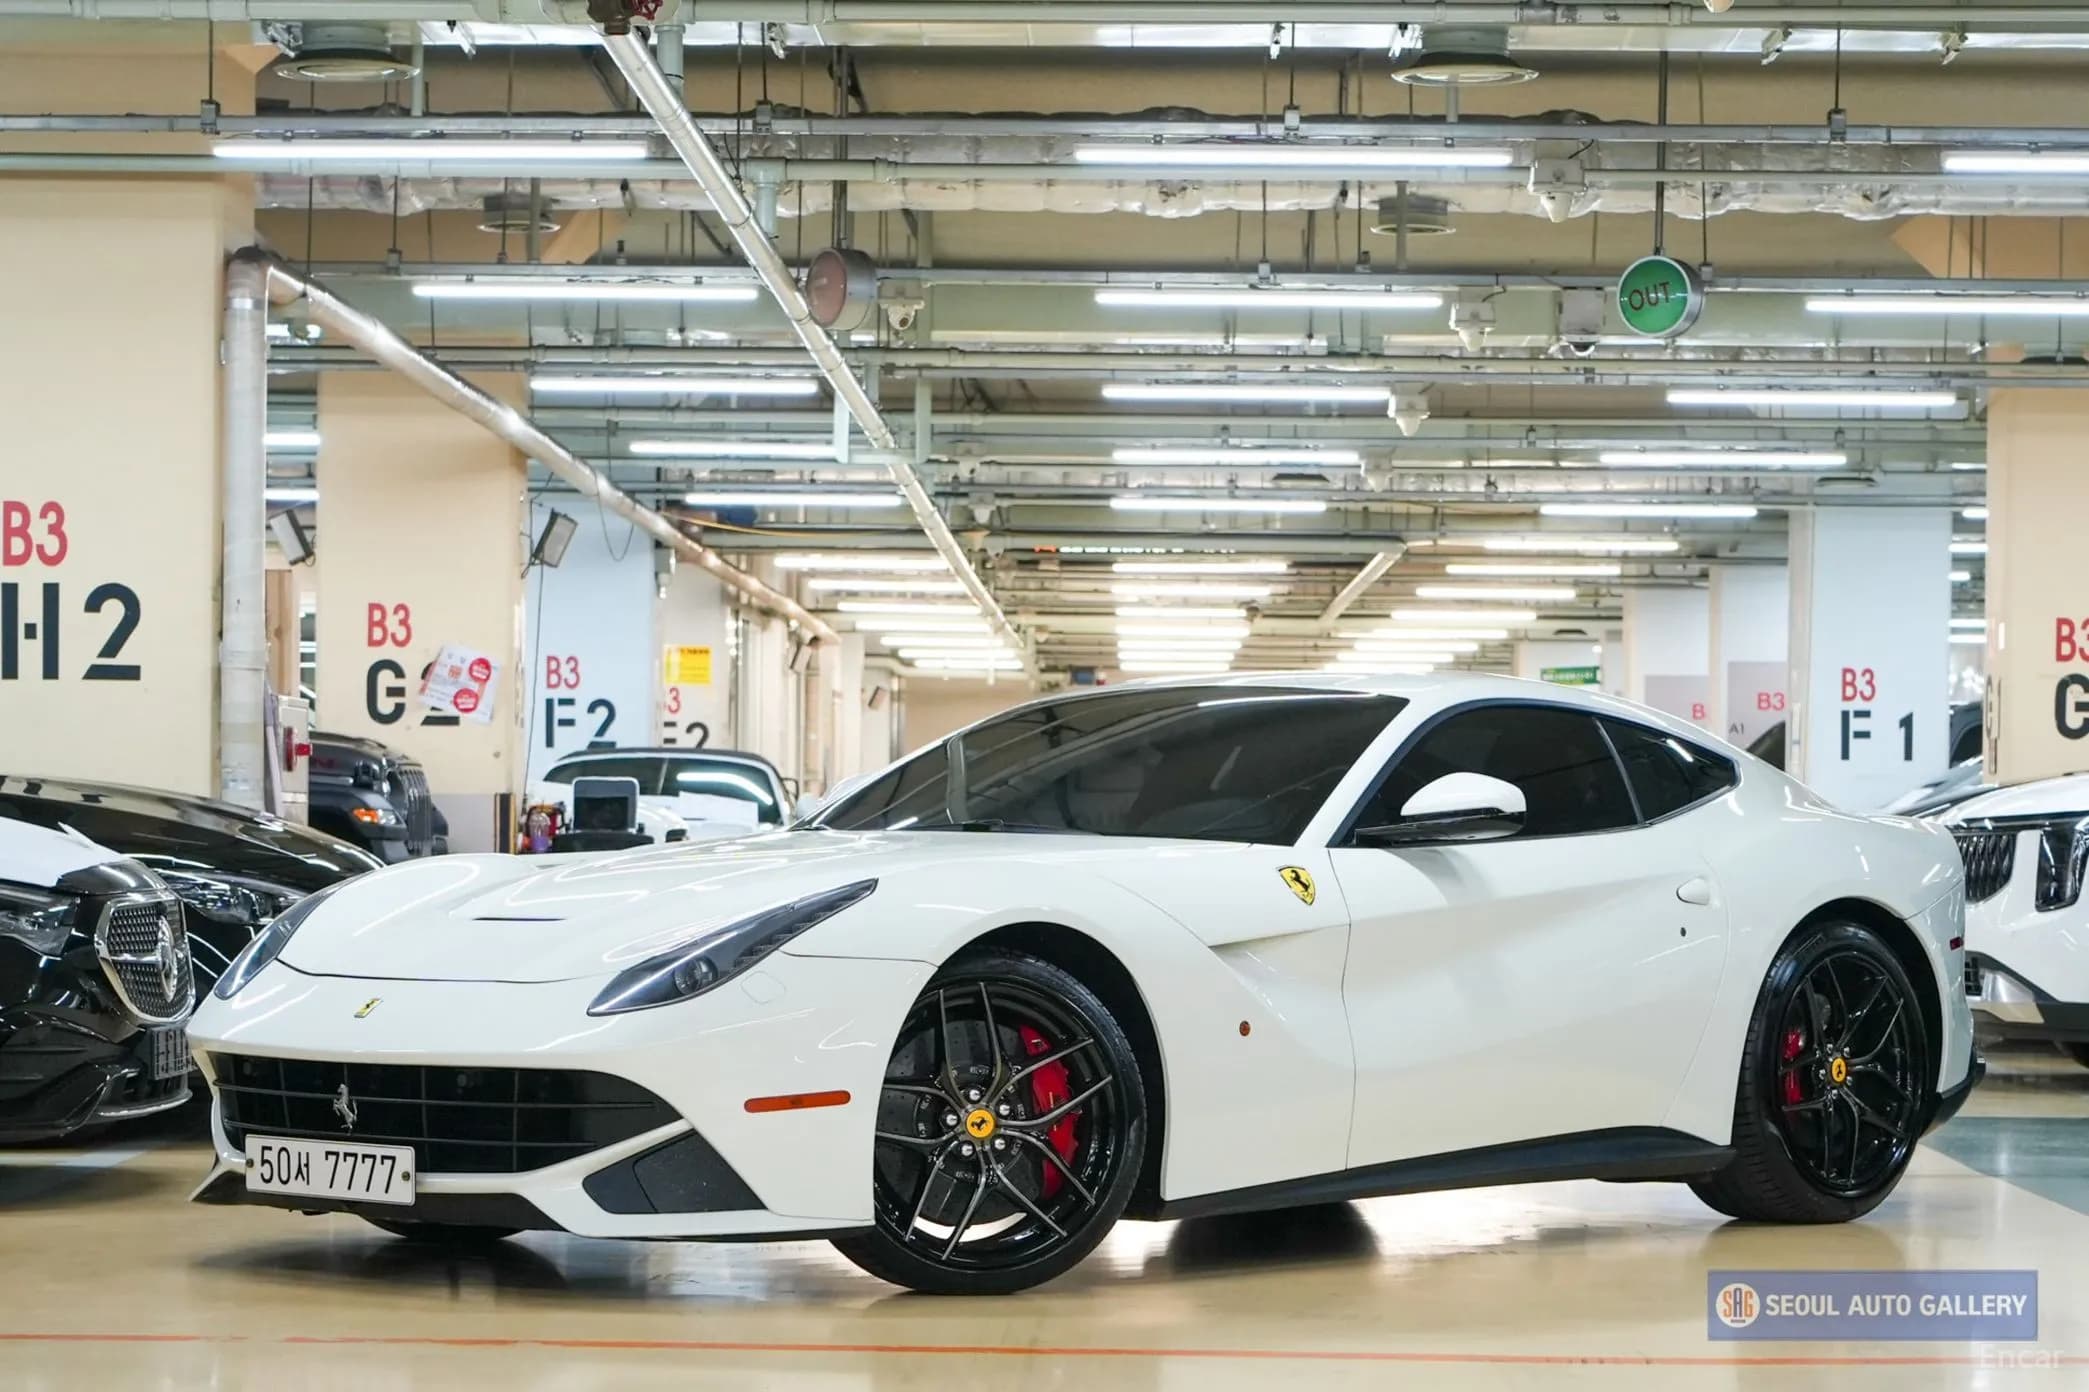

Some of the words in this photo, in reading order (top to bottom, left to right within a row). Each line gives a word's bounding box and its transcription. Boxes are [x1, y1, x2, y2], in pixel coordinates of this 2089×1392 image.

[1628, 281, 1671, 311] OUT
[2, 500, 68, 567] B3
[367, 602, 413, 647] B3
[546, 655, 581, 689] B3
[1840, 667, 1877, 703] B3
[664, 687, 681, 714] 3
[1757, 692, 1785, 711] B3
[260, 1145, 310, 1186] 50서
[325, 1151, 396, 1194] 7777
